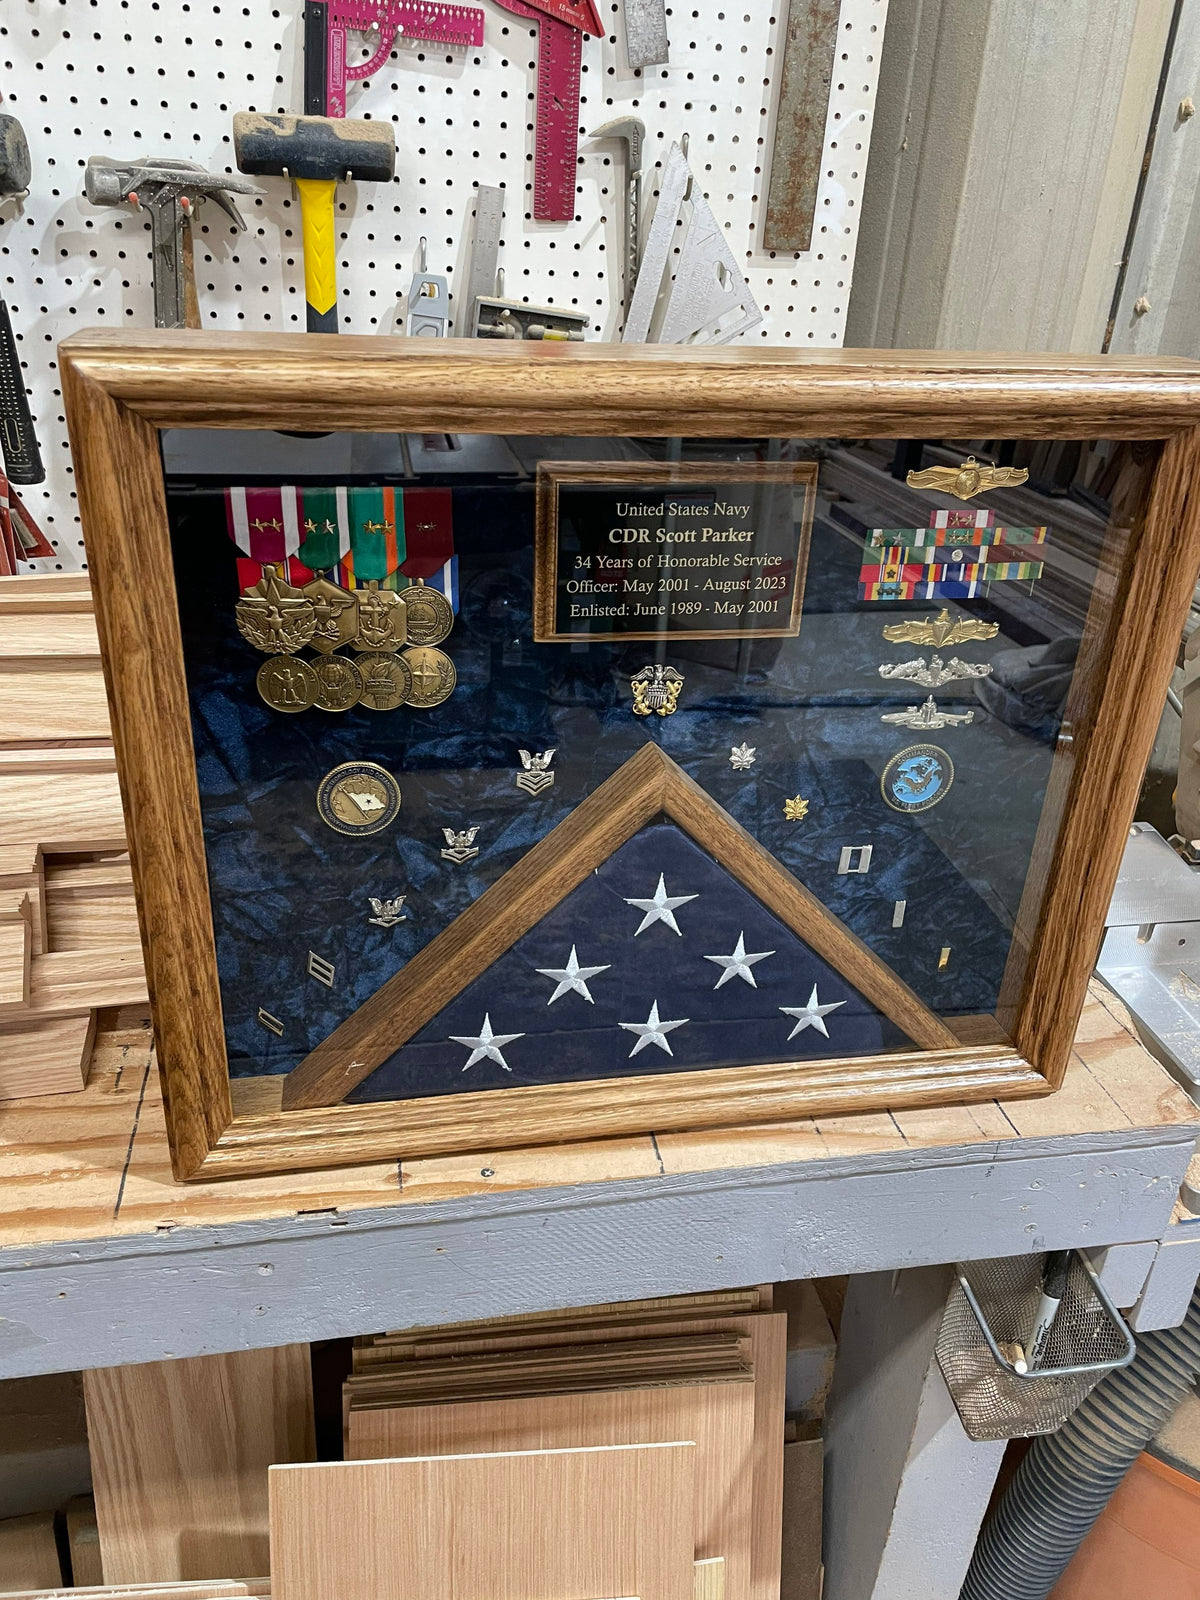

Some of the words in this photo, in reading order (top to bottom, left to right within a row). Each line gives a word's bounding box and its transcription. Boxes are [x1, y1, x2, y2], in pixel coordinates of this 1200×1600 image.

[616, 503, 664, 516] United
[669, 503, 709, 516] States
[713, 502, 750, 518] Navy
[609, 529, 651, 543] CDR
[656, 529, 697, 542] Scott
[702, 528, 754, 542] Parker
[574, 556, 591, 568] 34
[596, 556, 633, 568] Years
[638, 554, 653, 568] of
[657, 554, 729, 567] Honorable
[733, 553, 782, 566] Service
[567, 580, 618, 593] Officer:
[623, 580, 653, 594] May
[658, 579, 689, 591] 2001
[703, 579, 750, 593] August
[754, 577, 786, 589] 2023
[570, 604, 630, 617] Enlisted:
[634, 603, 666, 616] June
[671, 602, 702, 614] 1989
[714, 602, 743, 615] May
[748, 600, 778, 613] 2001
[897, 750, 938, 764] COMMANDER
[362, 767, 375, 775] AND
